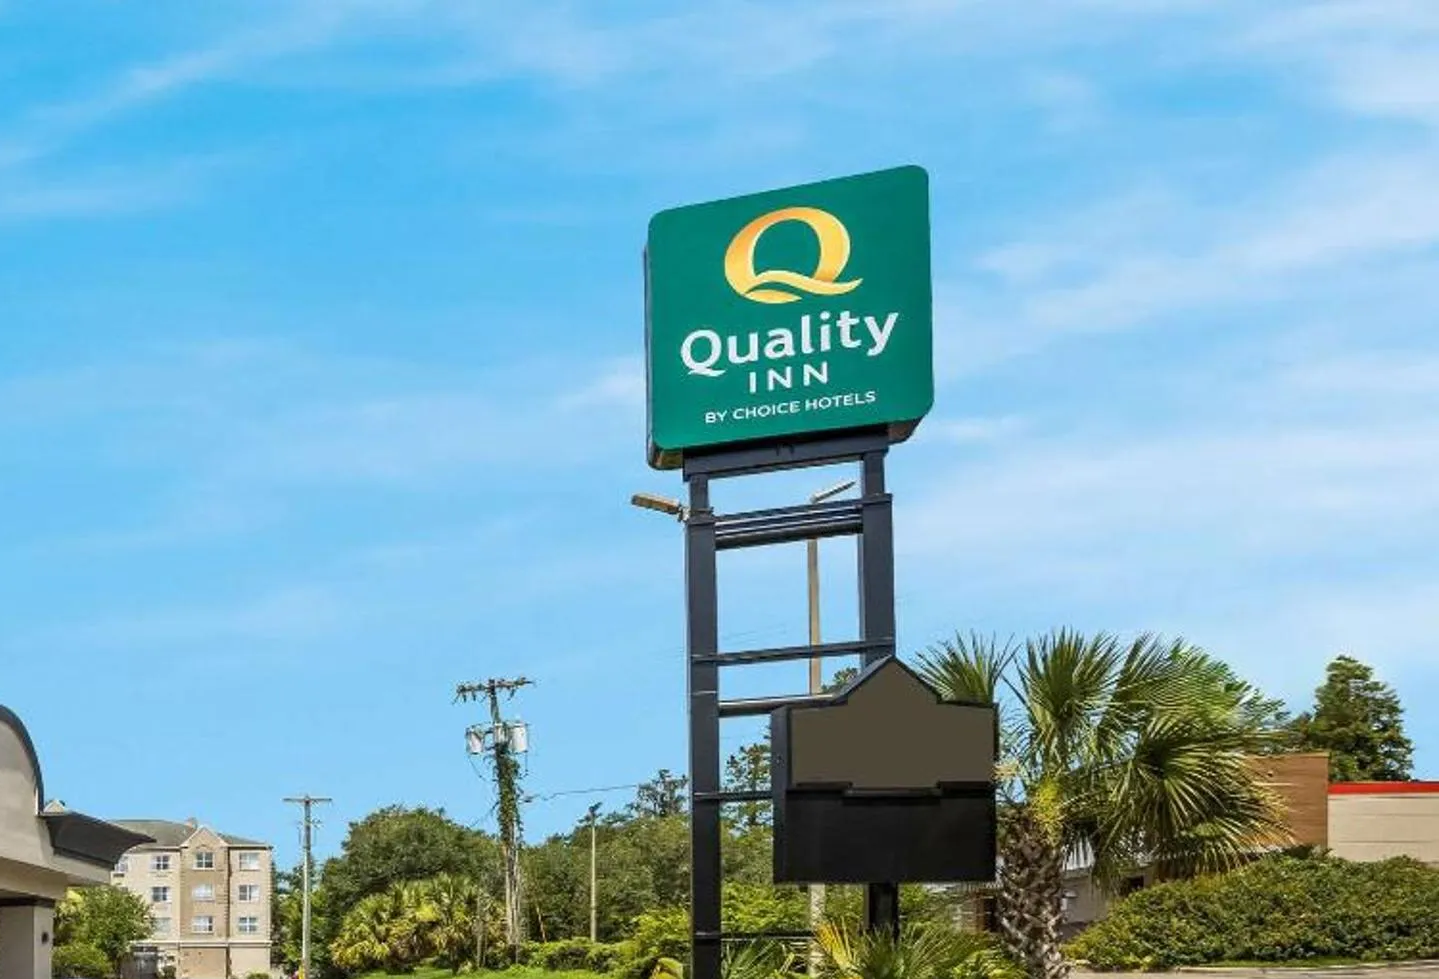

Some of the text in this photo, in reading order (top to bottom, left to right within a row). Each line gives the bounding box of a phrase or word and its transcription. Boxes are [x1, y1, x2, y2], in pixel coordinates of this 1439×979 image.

[724, 206, 863, 304] Q
[680, 310, 899, 377] Quality
[748, 361, 829, 393] INN
[705, 391, 876, 424] BY CHOICE HOTELS
